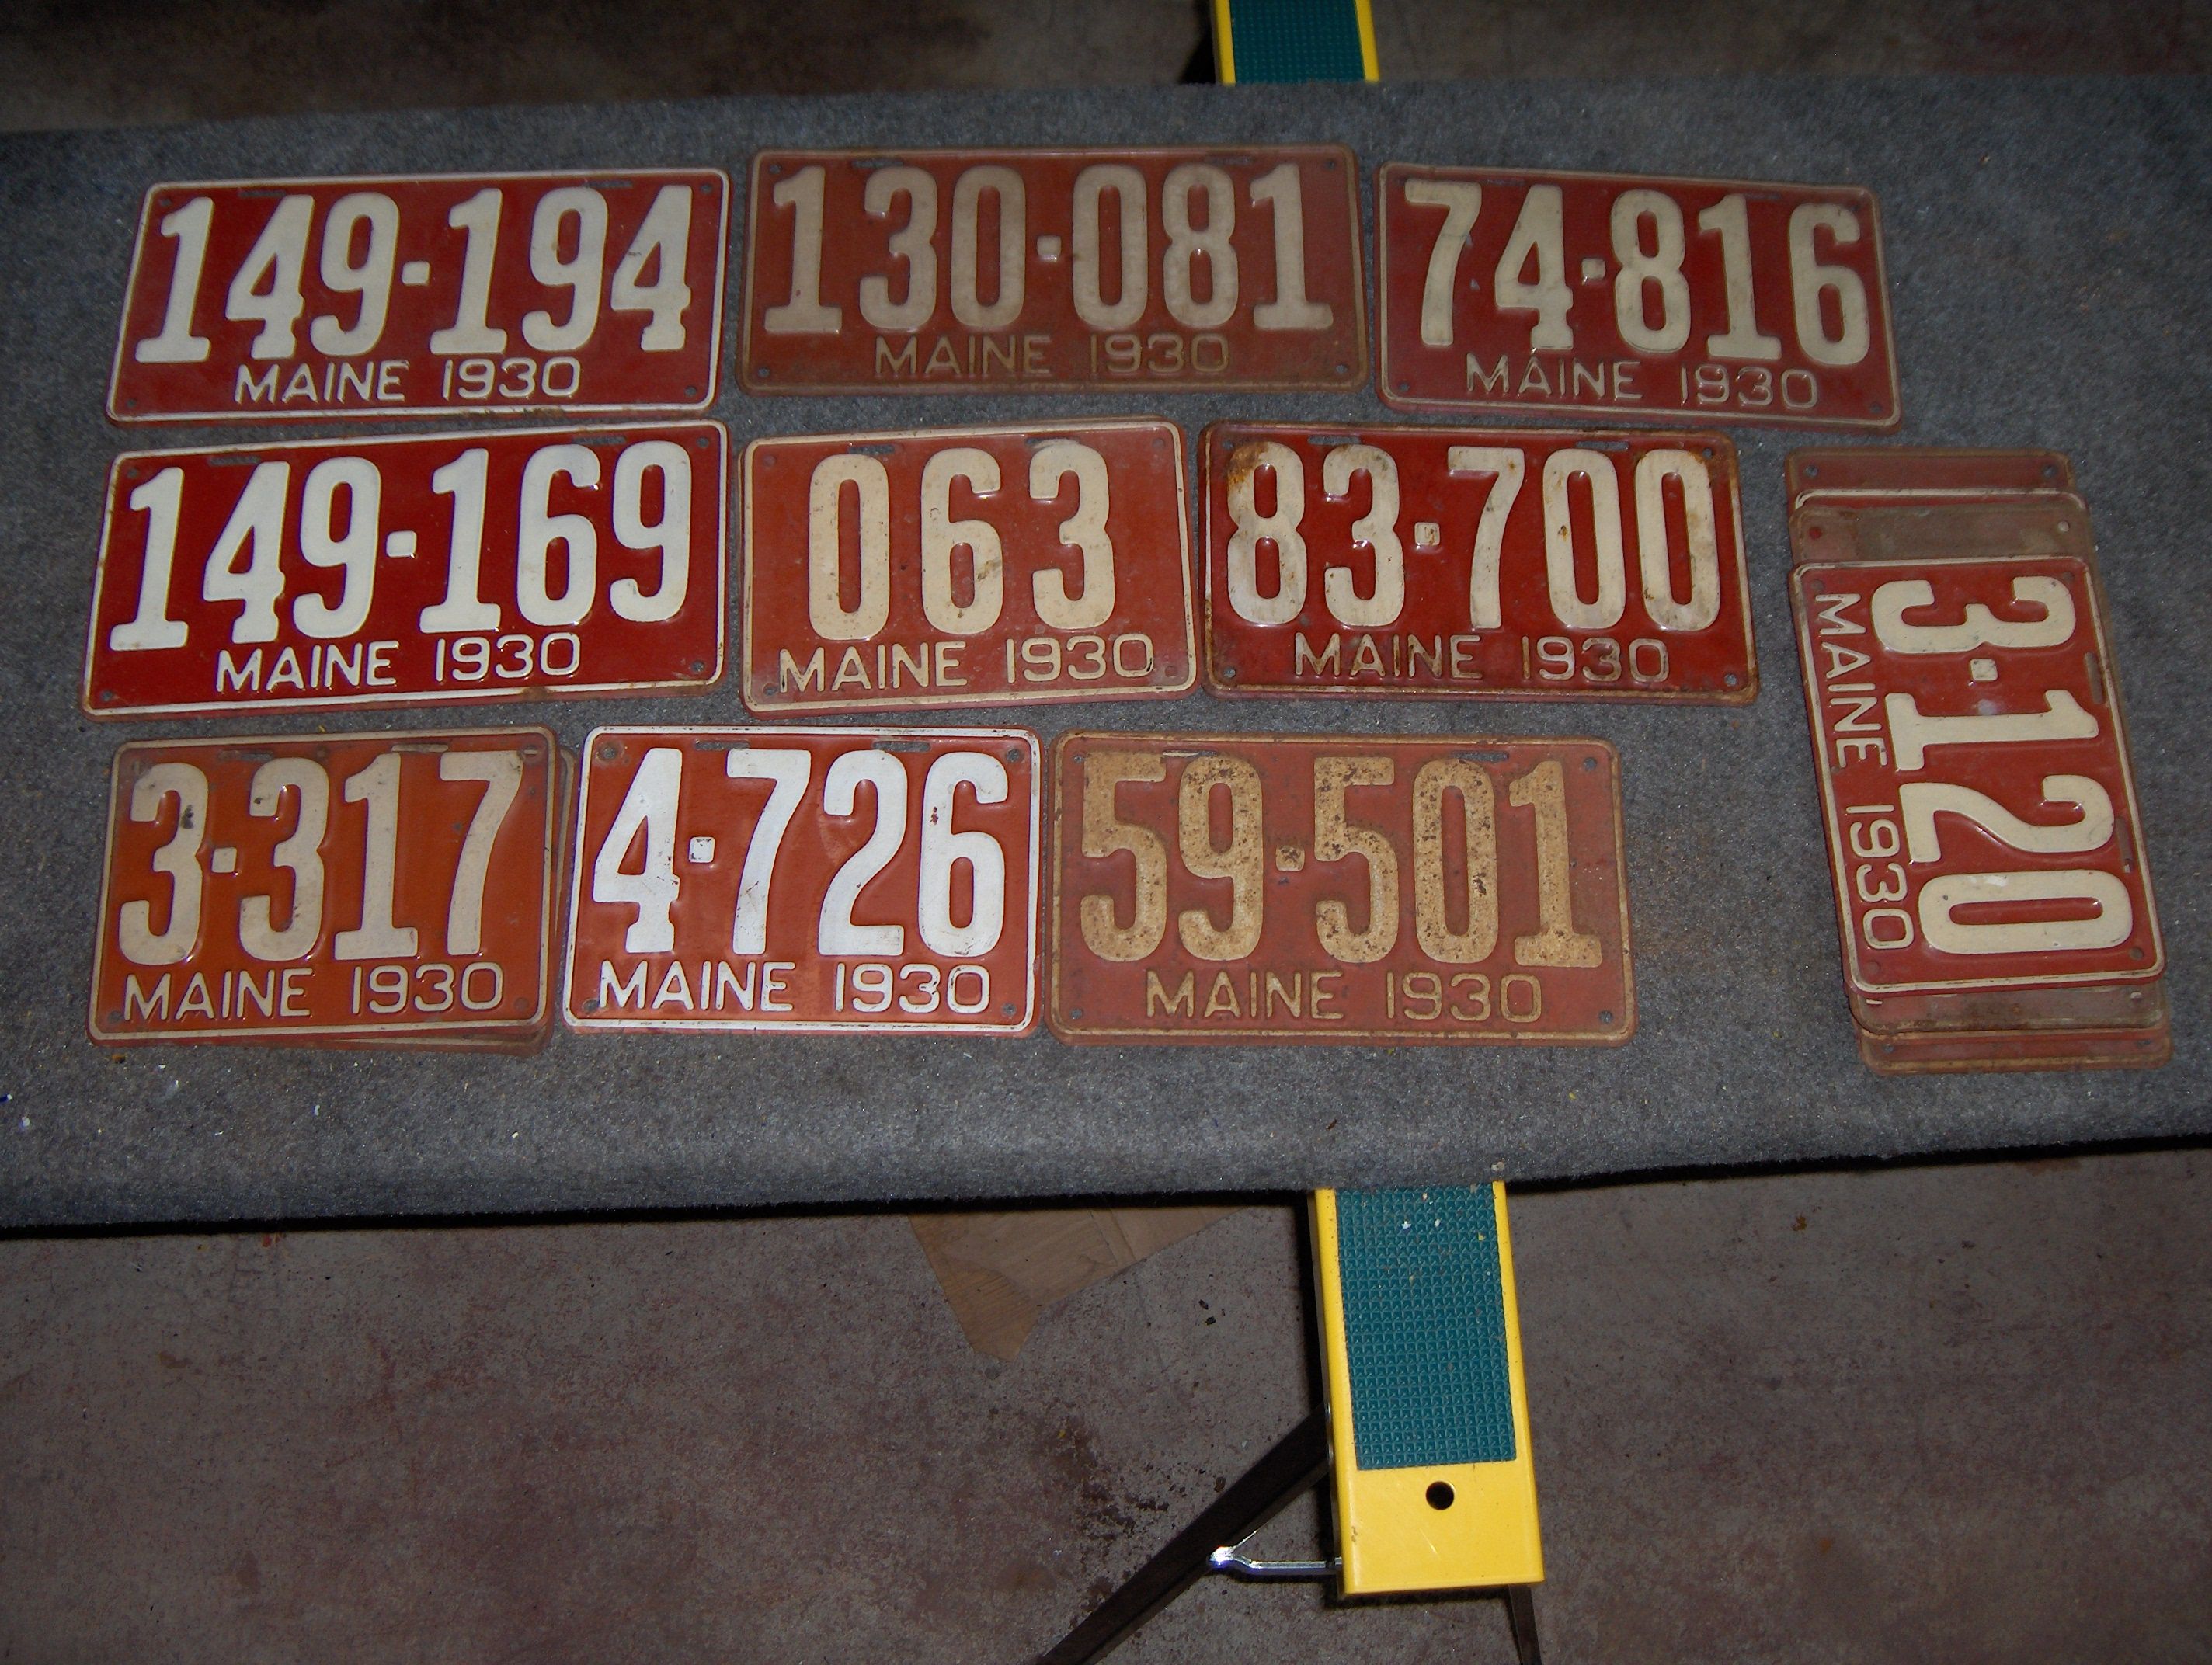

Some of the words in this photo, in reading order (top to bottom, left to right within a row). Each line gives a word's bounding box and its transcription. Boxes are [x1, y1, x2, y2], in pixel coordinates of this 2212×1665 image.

[235, 360, 409, 403] MAINE
[442, 357, 581, 399] 1930
[875, 335, 1053, 377] MAINE
[1090, 333, 1230, 374] 1930
[1466, 353, 1643, 401] MAINE
[1678, 363, 1819, 409] 1930
[809, 438, 1116, 641] 063
[217, 640, 399, 693] MAINE
[434, 633, 580, 683] 1930
[779, 641, 968, 694] MAINE
[1006, 633, 1154, 683] 1930
[1294, 633, 1483, 680] MAINE
[1522, 635, 1670, 684] 1930
[1814, 593, 1888, 770] MAINE
[1844, 804, 1915, 951] 1930
[123, 967, 314, 1022] MAINE
[351, 961, 503, 1015] 1930
[599, 959, 795, 1012] MAINE
[835, 962, 991, 1014] 1930
[1146, 970, 1344, 1020] MAINE
[1386, 971, 1542, 1023] 1930
